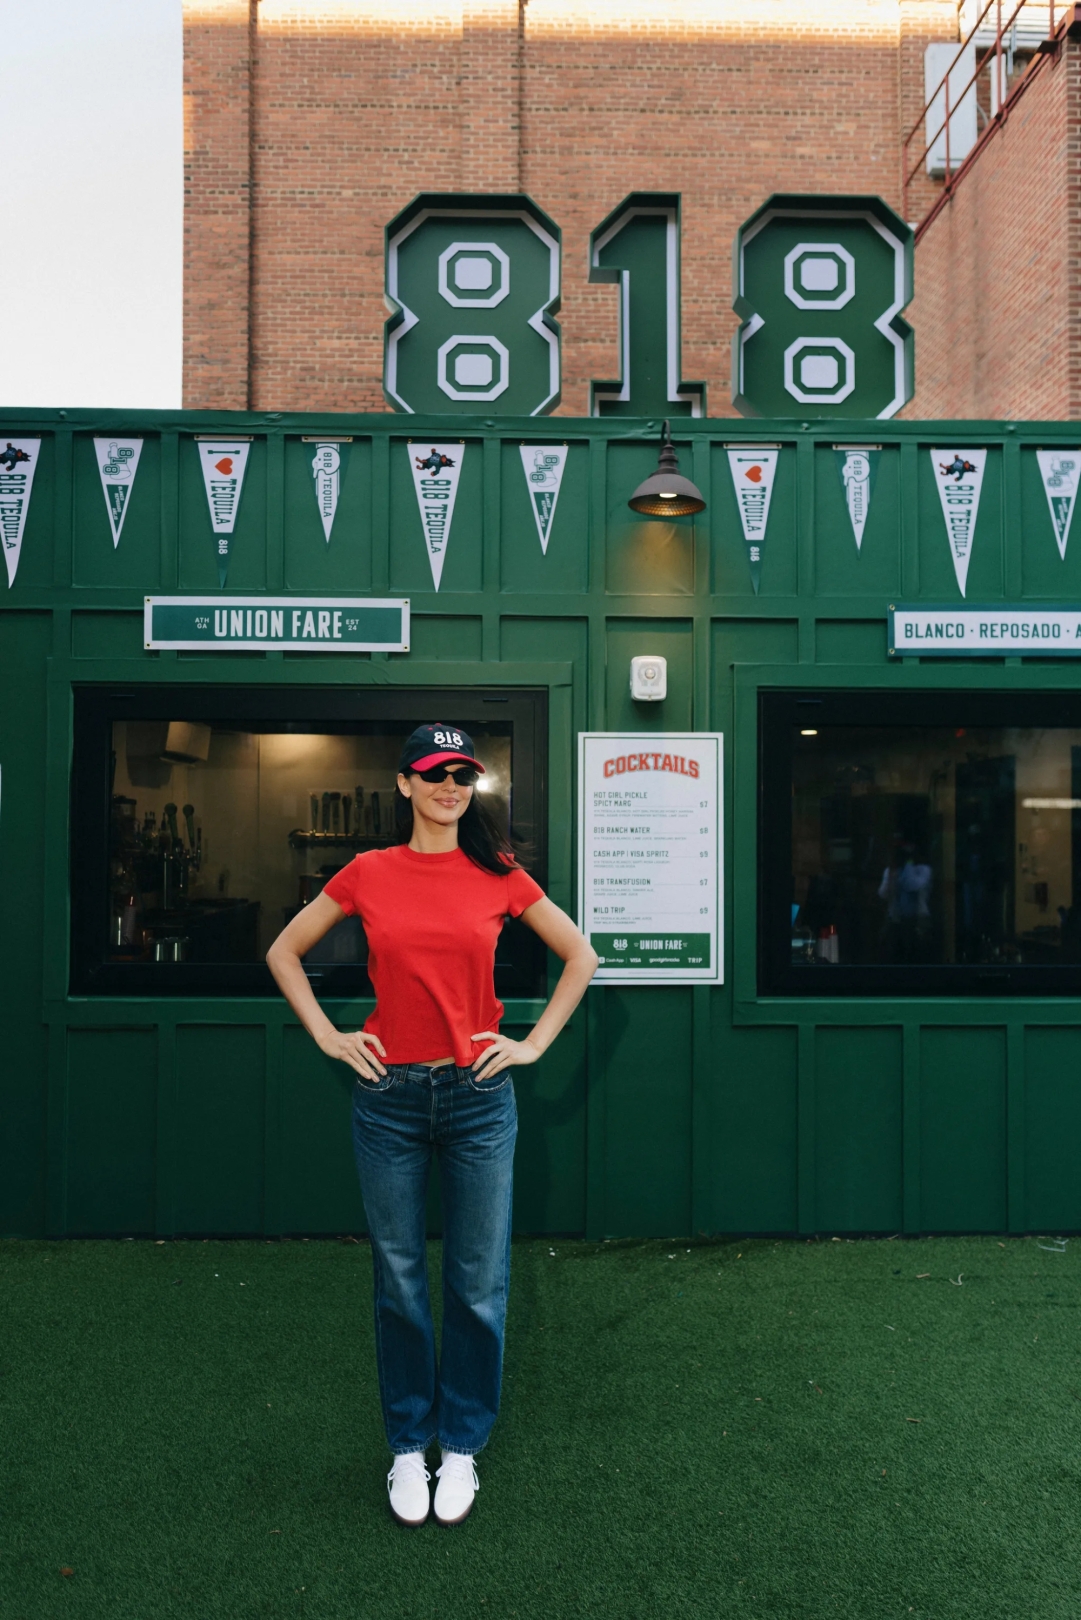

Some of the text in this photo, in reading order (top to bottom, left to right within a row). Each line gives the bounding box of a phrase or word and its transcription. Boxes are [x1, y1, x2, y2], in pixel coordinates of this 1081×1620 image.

[384, 191, 914, 419] 818
[102, 448, 134, 476] 818
[323, 452, 332, 468] 818
[530, 455, 560, 483] 818
[854, 460, 862, 475] 818
[210, 479, 237, 524] TEQUILA
[322, 478, 332, 517] TEQUILA
[741, 486, 767, 532] TEQUILA
[854, 485, 862, 524] TEQUILA
[0, 474, 27, 550] 818 TEQUILA
[420, 479, 451, 554] 818 TEQUILA
[944, 485, 974, 558] 818 TEQUILA
[218, 539, 228, 554] 818
[750, 546, 760, 562] 818
[214, 610, 342, 638] UNION FARE
[905, 623, 965, 638] BLANCO
[979, 623, 1060, 638] REPOSADO
[434, 731, 463, 746] 818
[603, 752, 700, 780] COCKTAILS
[613, 939, 628, 949] 818
[640, 940, 663, 950] UNION
[665, 940, 682, 950] FARE
